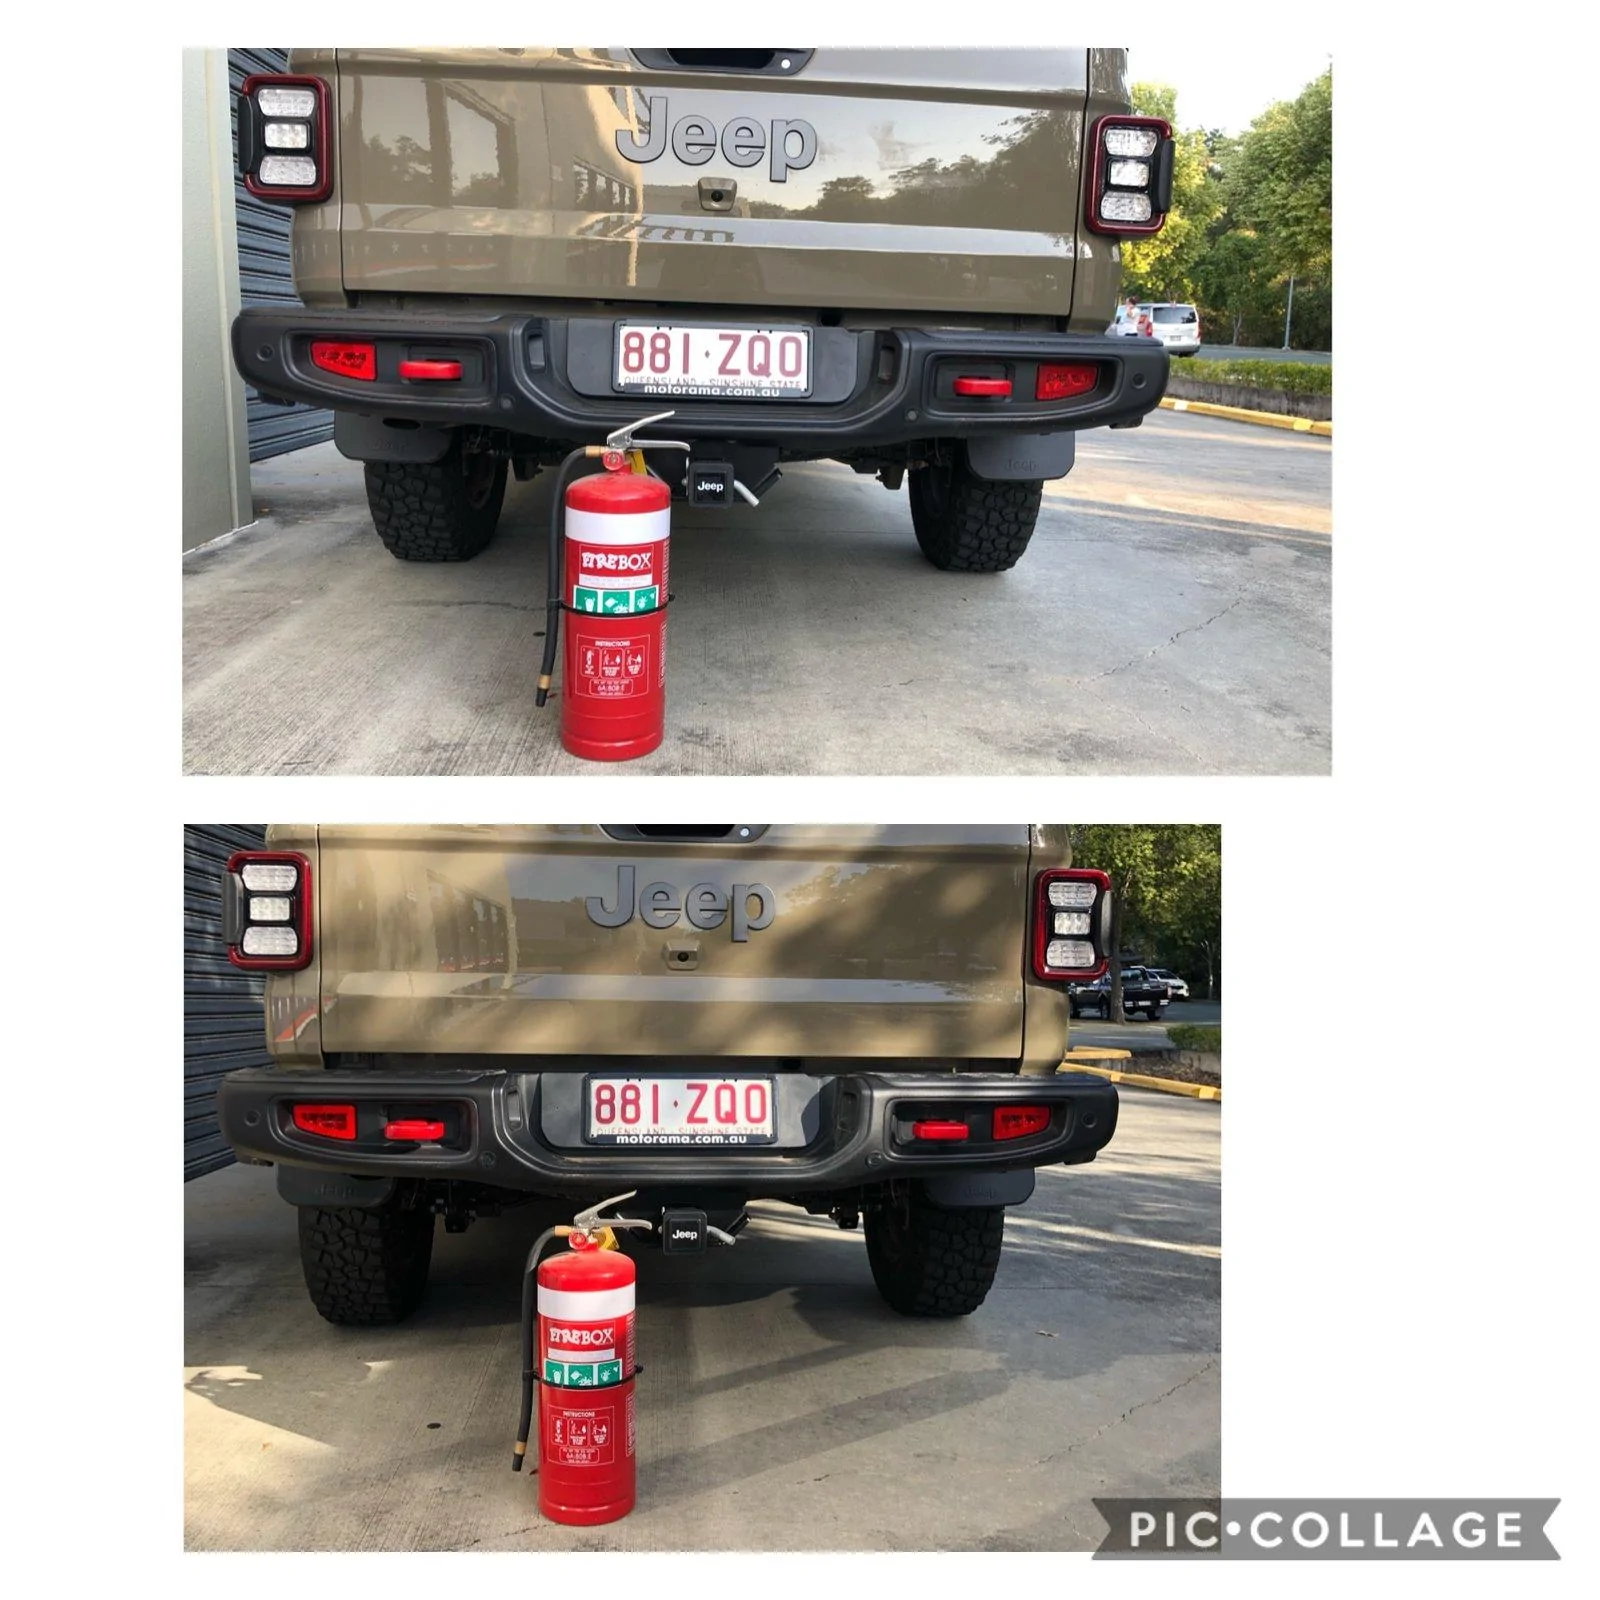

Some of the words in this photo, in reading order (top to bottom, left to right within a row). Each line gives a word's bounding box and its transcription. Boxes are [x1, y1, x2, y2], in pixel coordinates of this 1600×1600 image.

[615, 96, 817, 183] Jeep
[644, 384, 780, 397] motorama.com.au
[697, 481, 724, 493] Jeep
[581, 552, 652, 571] FIREBOX
[586, 865, 775, 943] Jeep
[616, 1134, 748, 1144] motorama.com.au
[672, 1229, 698, 1240] Jeep
[549, 1327, 614, 1346] FIREBOX
